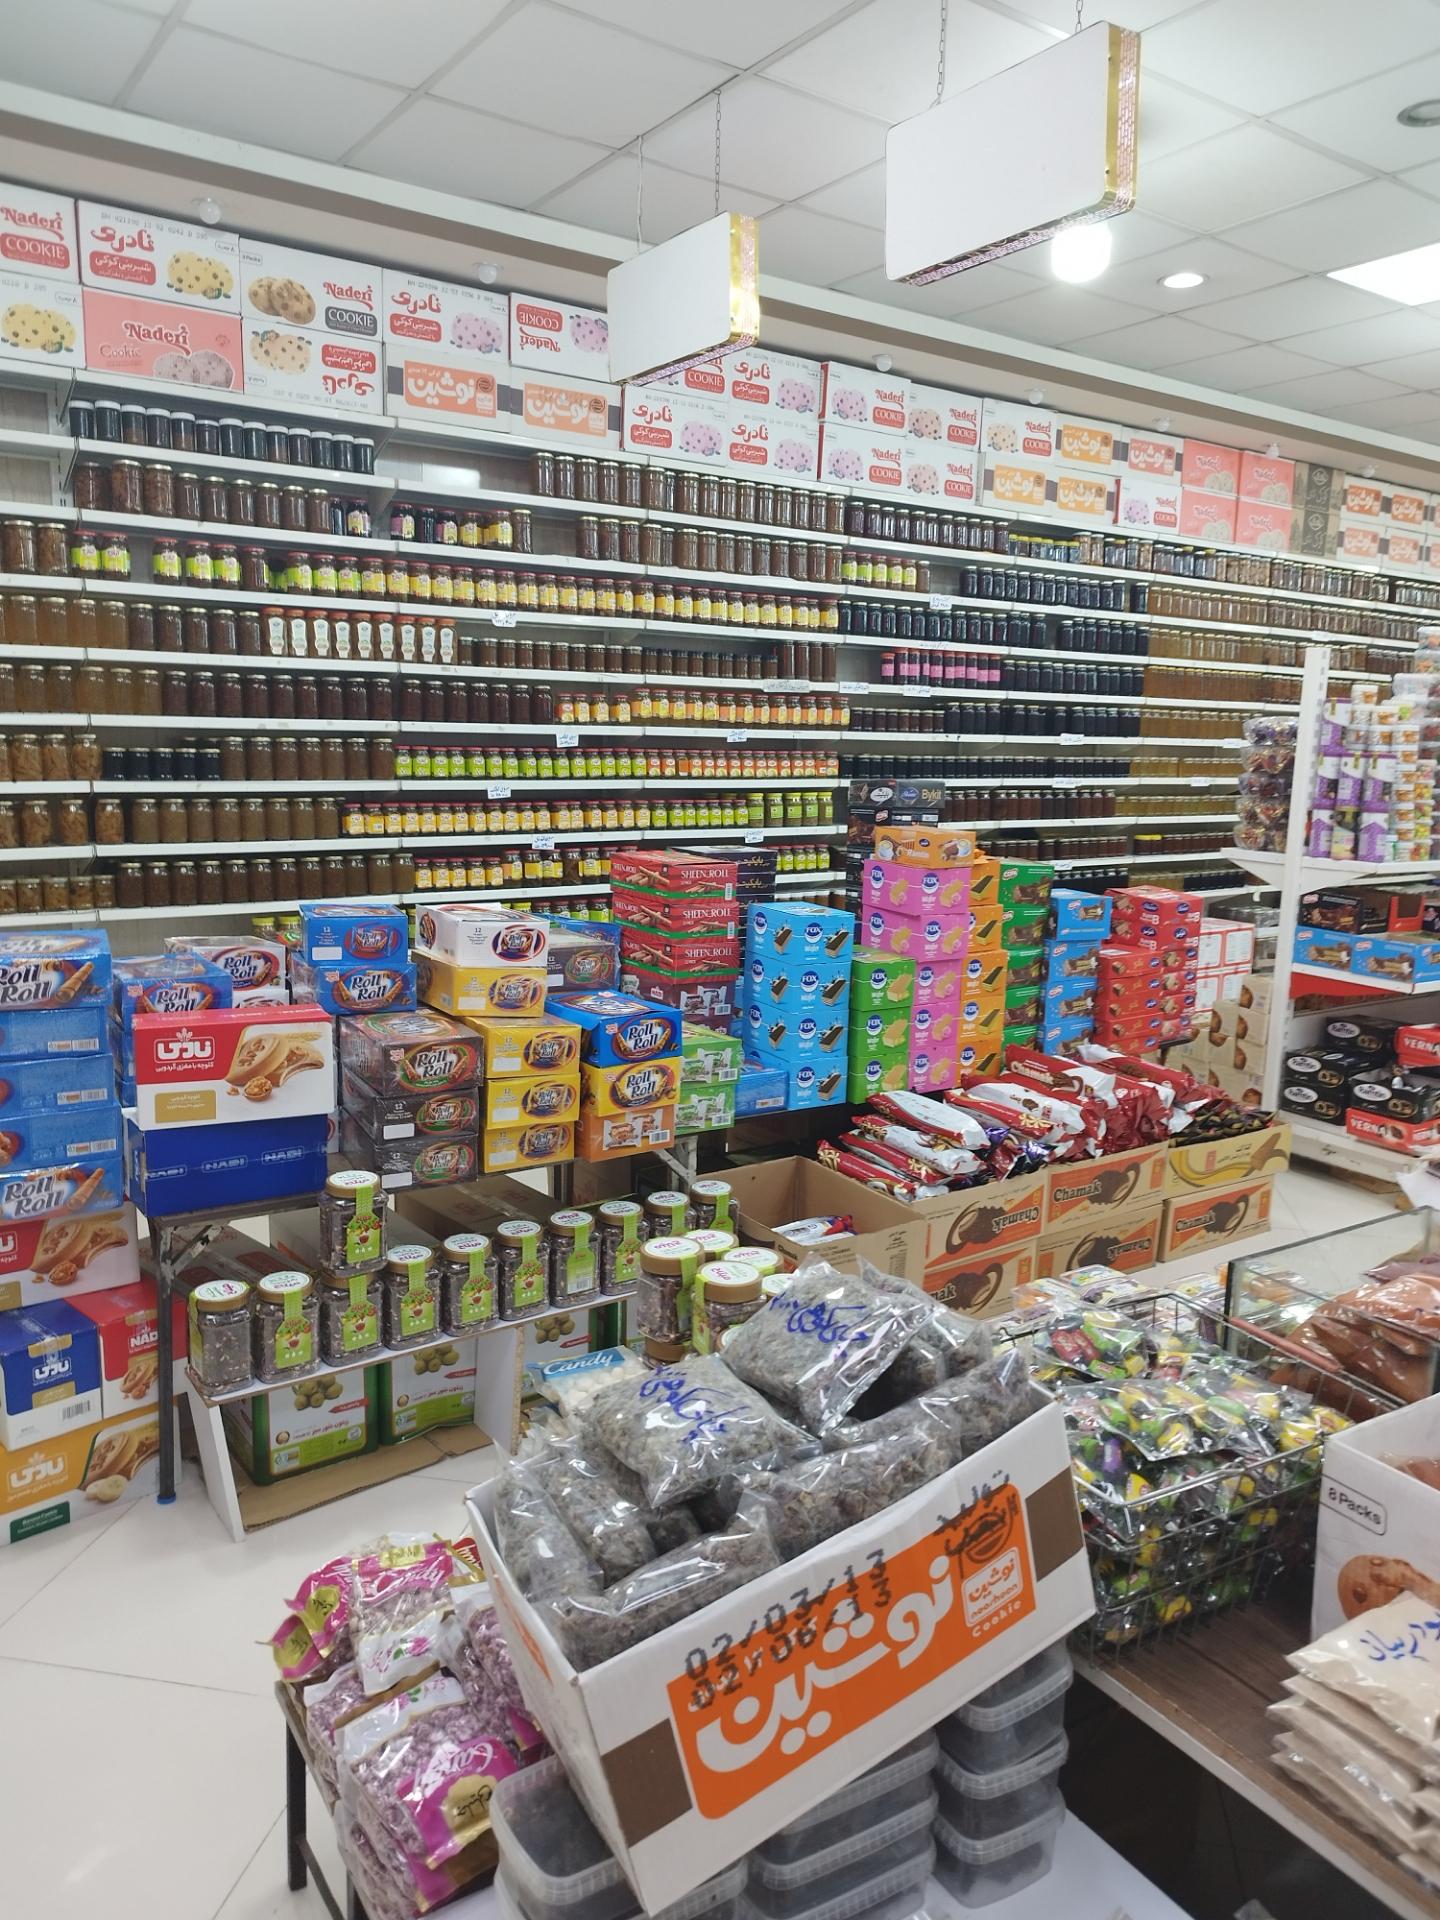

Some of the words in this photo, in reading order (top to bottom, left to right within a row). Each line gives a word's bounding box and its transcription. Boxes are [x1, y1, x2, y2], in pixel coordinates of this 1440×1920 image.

[0, 207, 65, 241] Naderi
[90, 226, 155, 252] نادری
[5, 237, 66, 260] COOKIE
[323, 281, 374, 311] Naderi
[391, 292, 441, 314] نادری
[328, 309, 375, 327] COOKIE
[519, 311, 560, 328] COOKIE
[123, 322, 192, 356] Naderi
[519, 327, 561, 352] Naderi
[100, 345, 143, 359] Cookie
[687, 372, 723, 387] COOKIE
[733, 362, 771, 380] نادری
[322, 372, 375, 397] نادری
[407, 371, 475, 405] نوشین
[875, 389, 904, 410] Naderi
[632, 405, 673, 424] نادری
[875, 410, 903, 423] COOKIE
[949, 408, 977, 428] Naderi
[731, 424, 769, 442] نادری
[950, 429, 976, 440] COOKIE
[871, 448, 901, 468] Naderi
[871, 468, 899, 480] COOKIE
[946, 463, 973, 482] Naderi
[946, 485, 972, 497] COOKIE
[921, 789, 942, 802] Bykit
[805, 926, 822, 935] FOX
[223, 955, 252, 968] Roll
[229, 964, 257, 978] Roll
[801, 975, 817, 984] FOX
[871, 971, 886, 980] FOX
[351, 974, 381, 989] Roll
[2, 981, 52, 1003] Roll
[156, 986, 189, 1004] Roll
[357, 985, 387, 1001] Roll
[163, 997, 196, 1012] Roll
[628, 1023, 653, 1040] Roll
[799, 1021, 816, 1031] FOX
[867, 1018, 881, 1027] FOX
[633, 1034, 659, 1051] Roll
[1403, 1037, 1440, 1056] VERNA
[417, 1050, 448, 1066] Roll
[423, 1062, 455, 1078] Roll
[797, 1070, 814, 1080] FOX
[866, 1065, 881, 1073] FOX
[626, 1070, 651, 1087] Roll
[631, 1082, 656, 1099] Roll
[1350, 1117, 1386, 1137] VERNA
[4, 1175, 54, 1199] Roll
[1053, 1179, 1103, 1203] Chamak
[14, 1189, 66, 1218] Roll
[992, 1206, 1040, 1233] Chamak
[543, 1352, 614, 1376] Candy
[1328, 1487, 1337, 1501] 8
[1339, 1492, 1382, 1526] Packs
[967, 1557, 1016, 1602] نوشین
[685, 1548, 888, 1681] 02/03/13
[971, 1599, 1023, 1638] Cookie
[695, 1554, 955, 1775] نوشین
